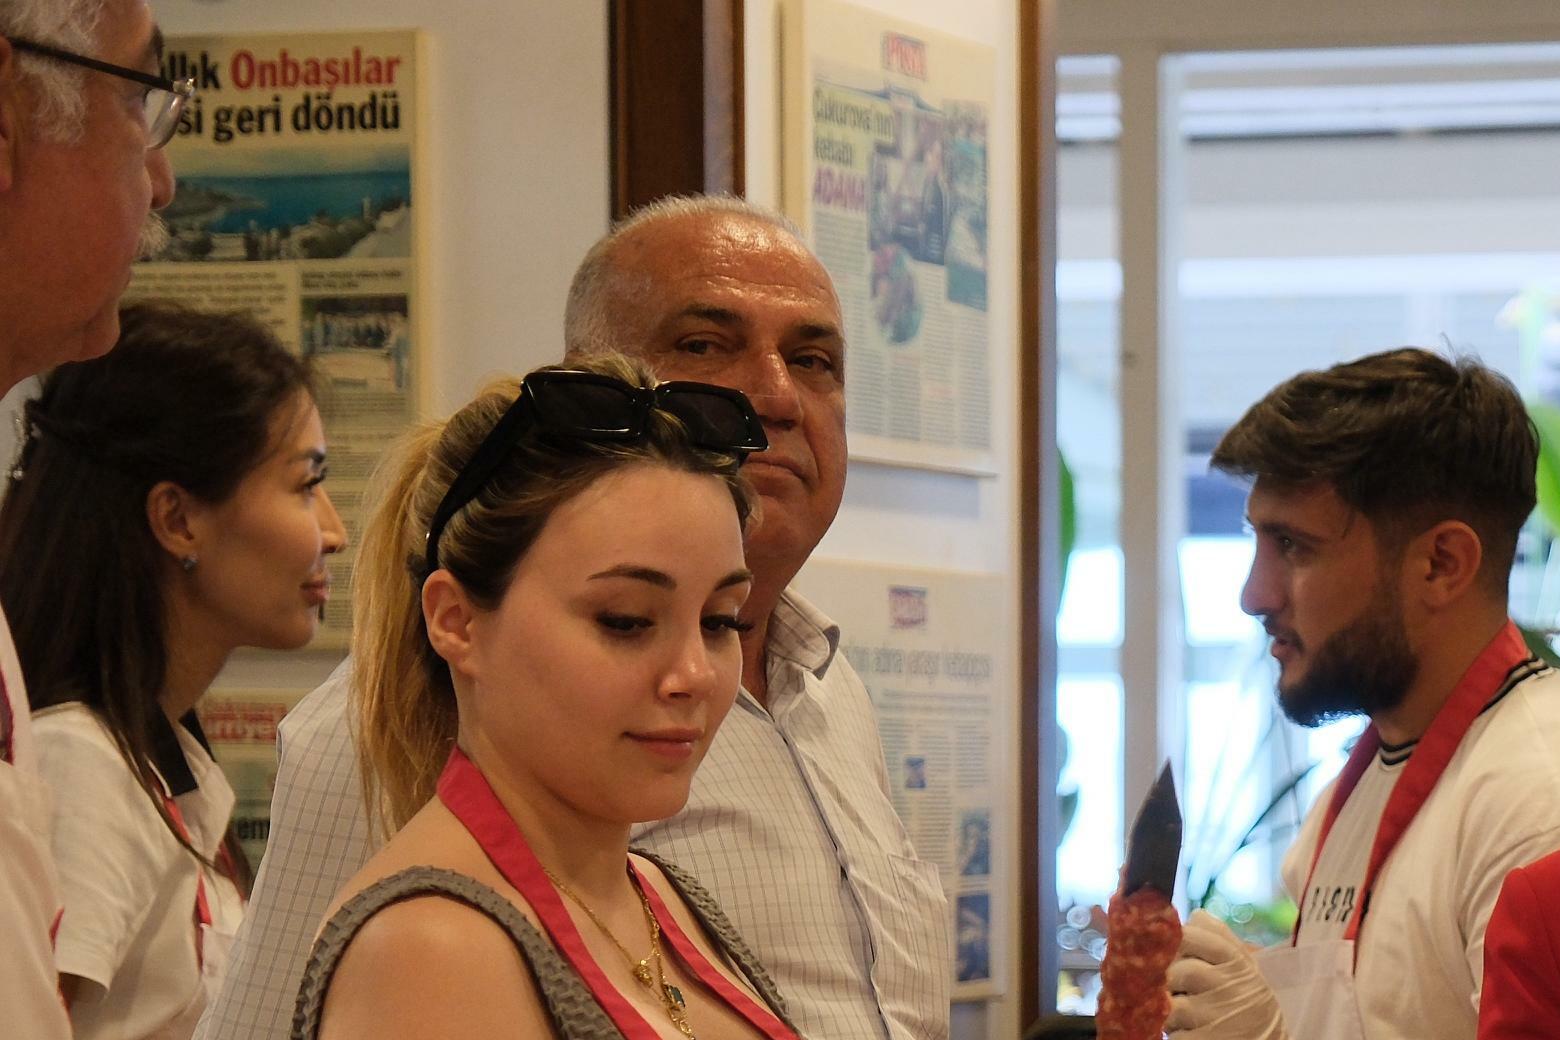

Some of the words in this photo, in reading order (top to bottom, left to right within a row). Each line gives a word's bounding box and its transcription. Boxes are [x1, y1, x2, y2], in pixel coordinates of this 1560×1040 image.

[230, 46, 402, 92] Onbaşılar
[212, 95, 282, 142] geri
[292, 90, 400, 131] döndü
